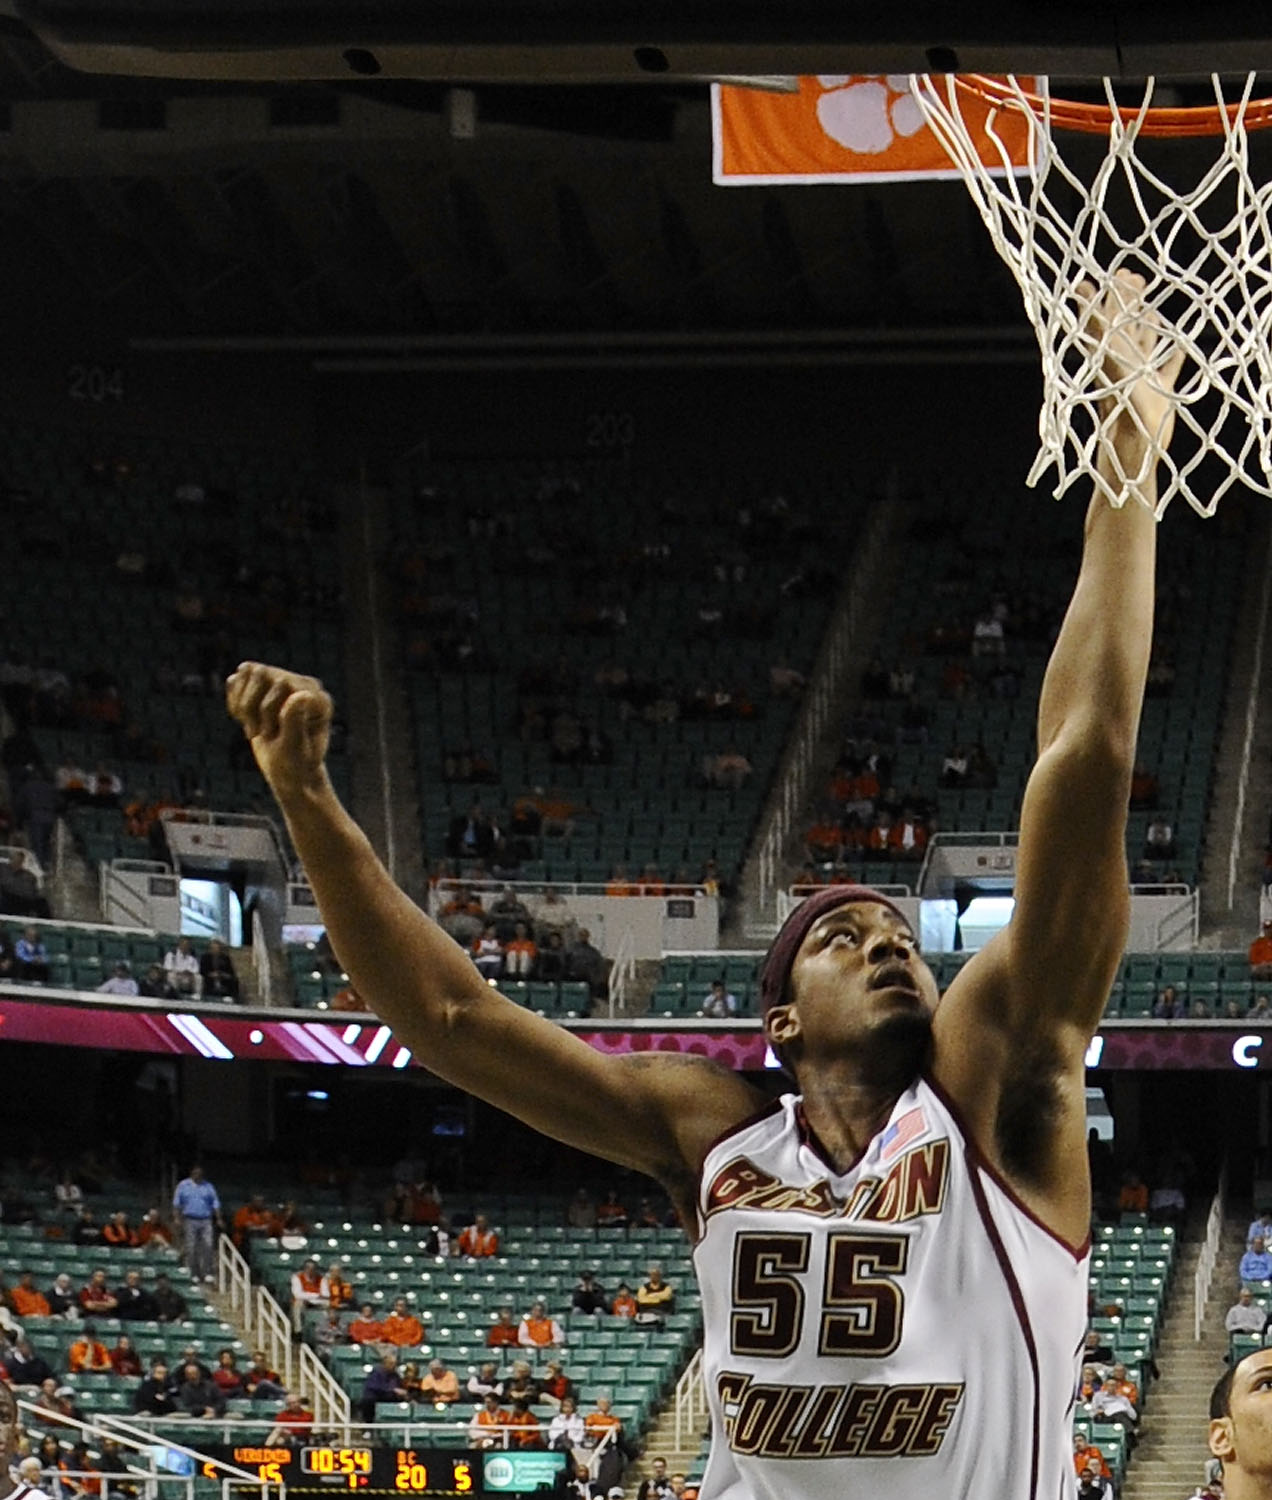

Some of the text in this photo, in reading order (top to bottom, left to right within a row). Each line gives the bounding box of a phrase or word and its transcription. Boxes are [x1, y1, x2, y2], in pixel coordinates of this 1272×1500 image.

[730, 1231, 910, 1359] 55
[716, 1370, 966, 1460] COLLEGE
[258, 1463, 283, 1484] 15
[311, 1449, 370, 1473] 10:54
[395, 1464, 427, 1490] 20
[454, 1465, 472, 1491] 5
